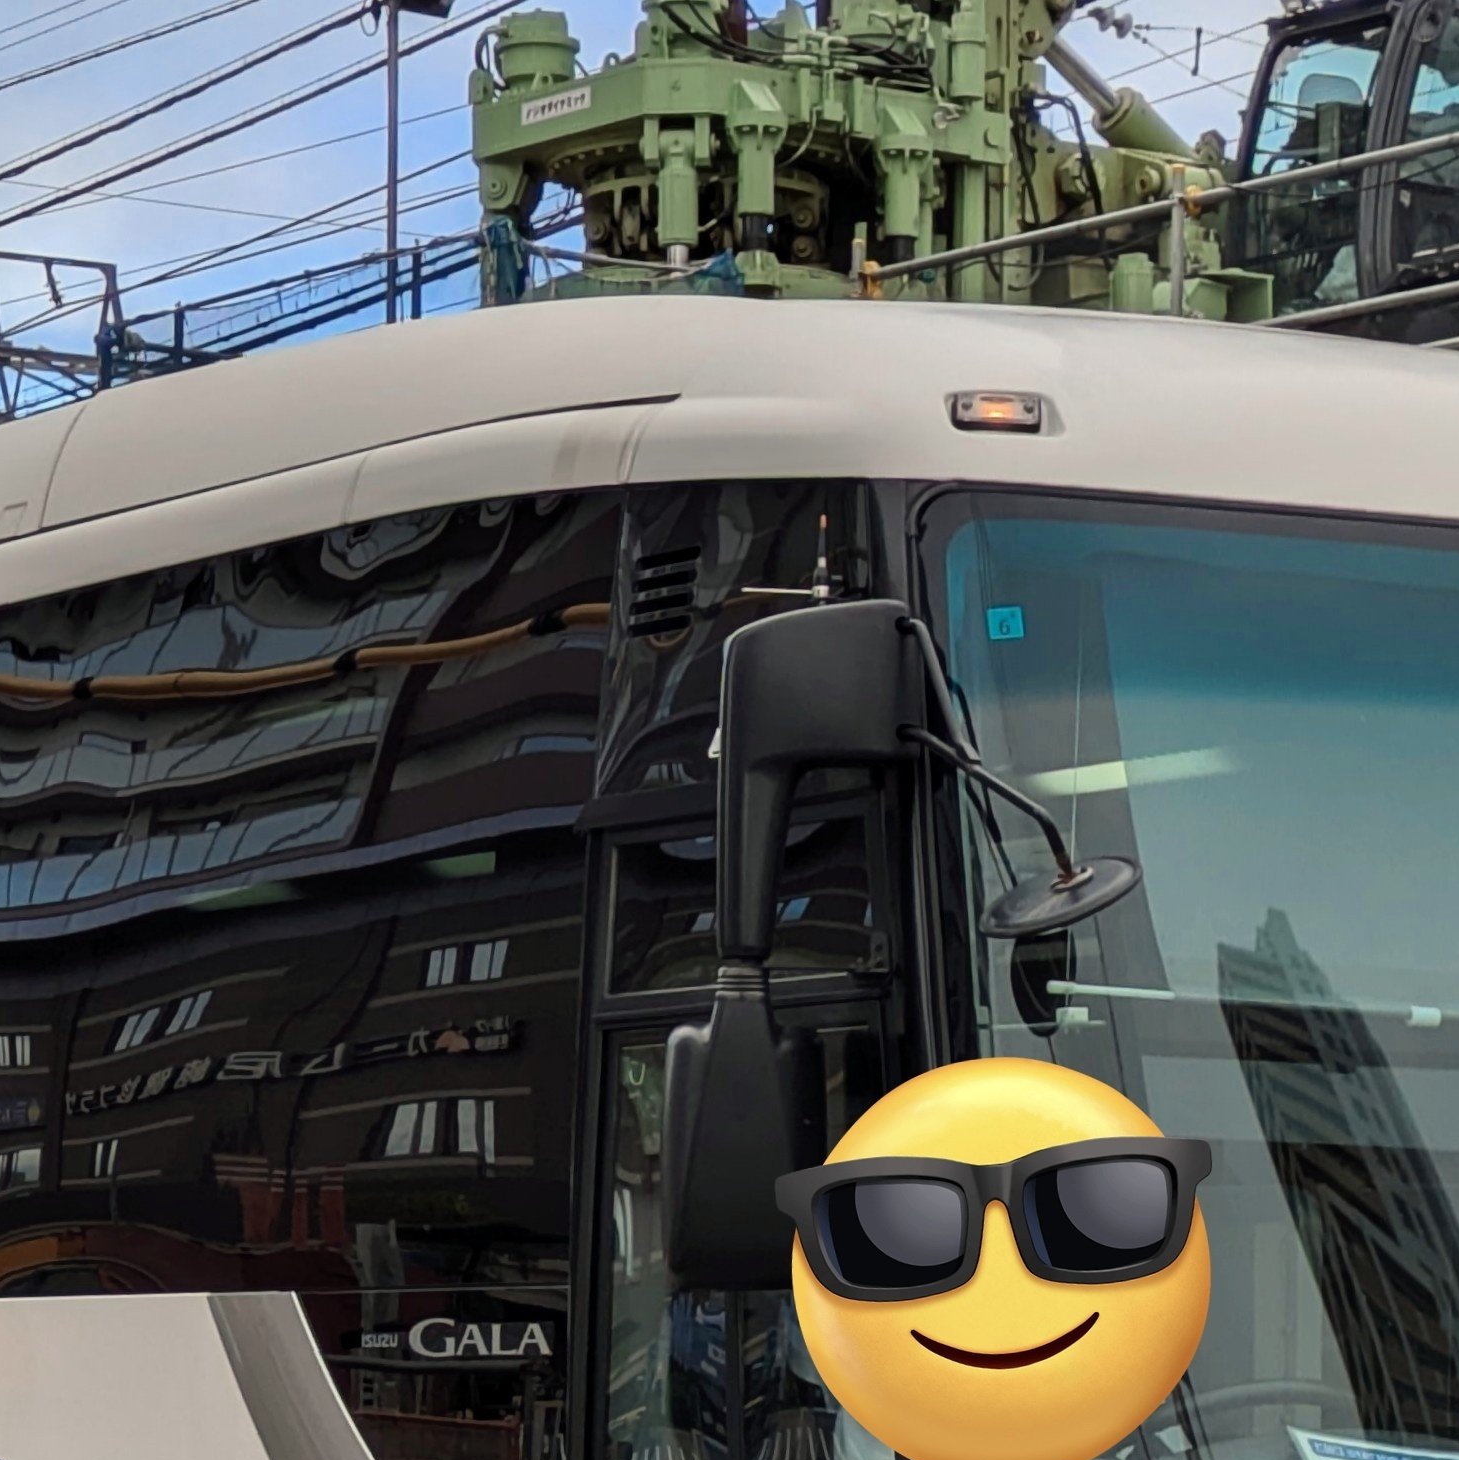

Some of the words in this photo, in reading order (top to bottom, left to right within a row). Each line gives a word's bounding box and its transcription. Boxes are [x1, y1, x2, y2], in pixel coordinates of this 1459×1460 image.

[999, 619, 1011, 635] 6
[361, 1333, 399, 1348] ISUZU
[408, 1317, 553, 1358] GALA
